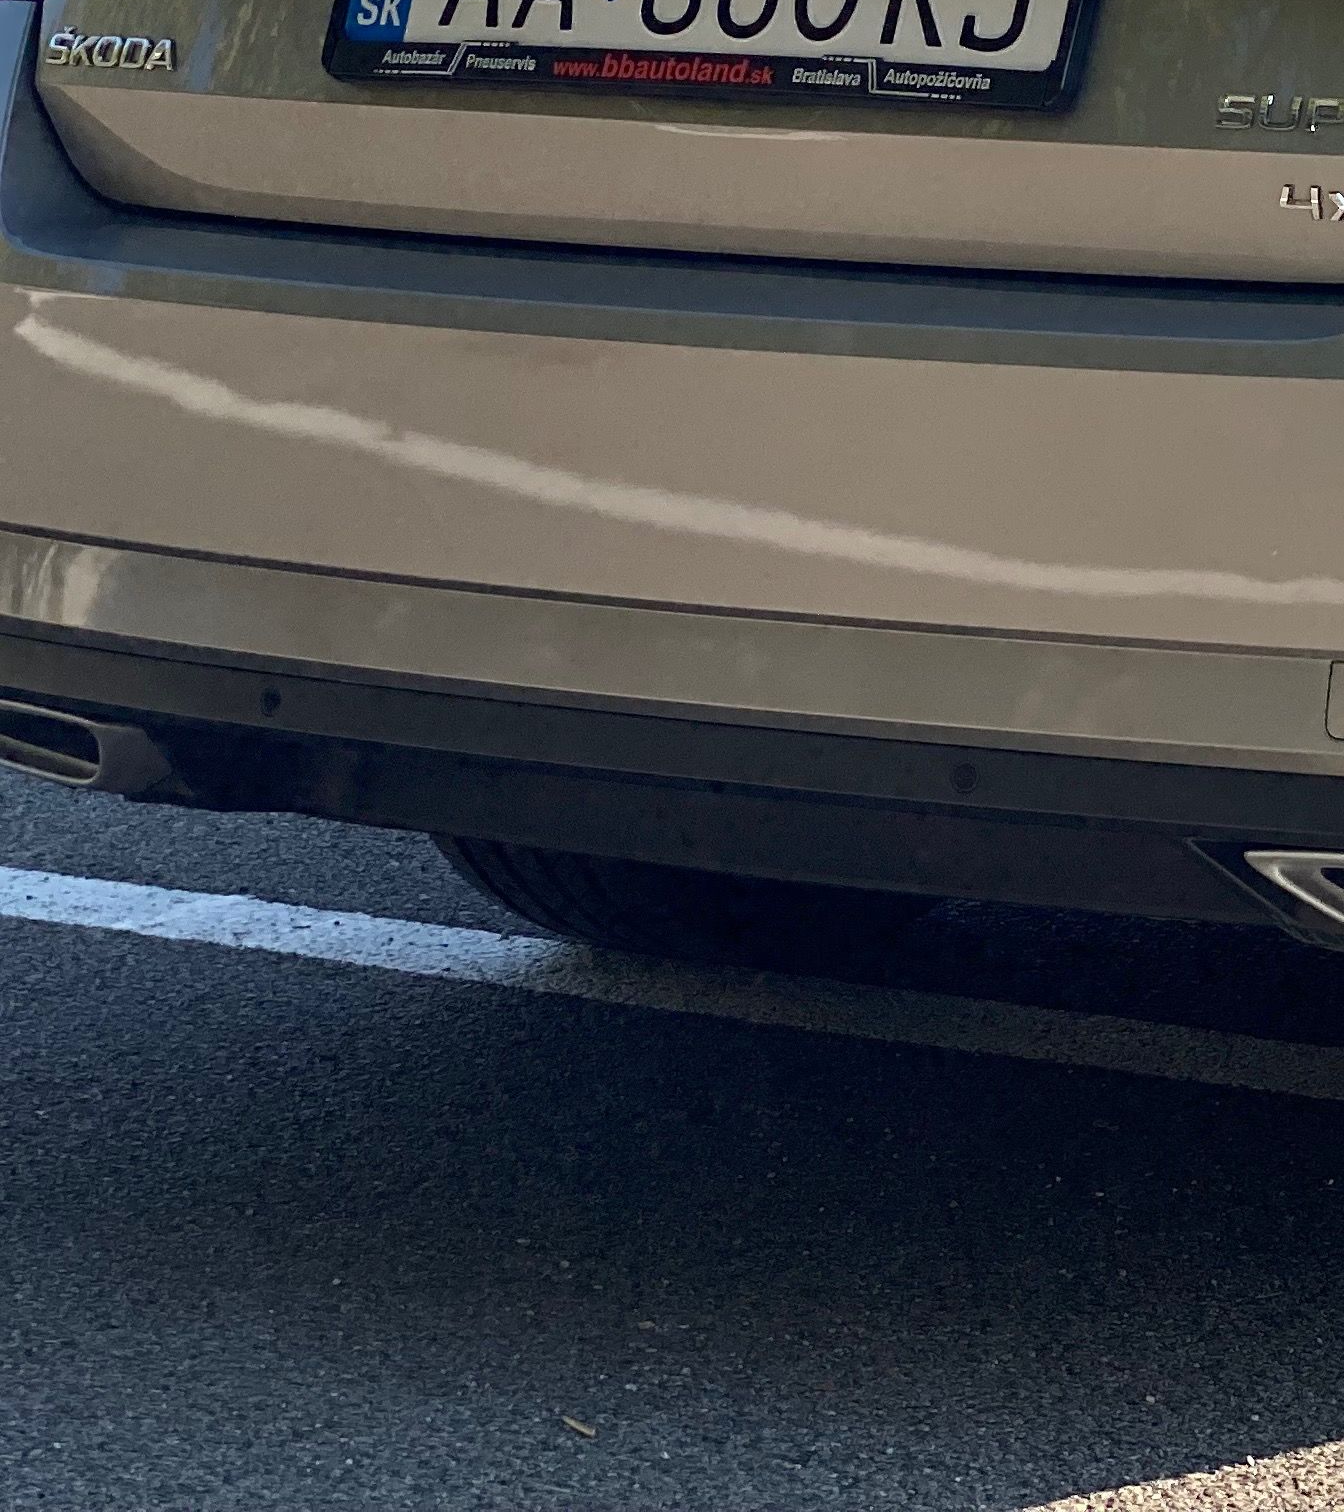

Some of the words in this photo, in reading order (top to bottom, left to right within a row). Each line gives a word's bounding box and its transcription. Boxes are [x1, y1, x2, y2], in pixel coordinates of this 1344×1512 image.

[45, 25, 175, 71] ŠKODA
[382, 48, 447, 66] Autobazár
[466, 53, 536, 72] Pneuservis
[553, 54, 773, 86] www.bbautoland.sk
[792, 67, 861, 88] Bratislava
